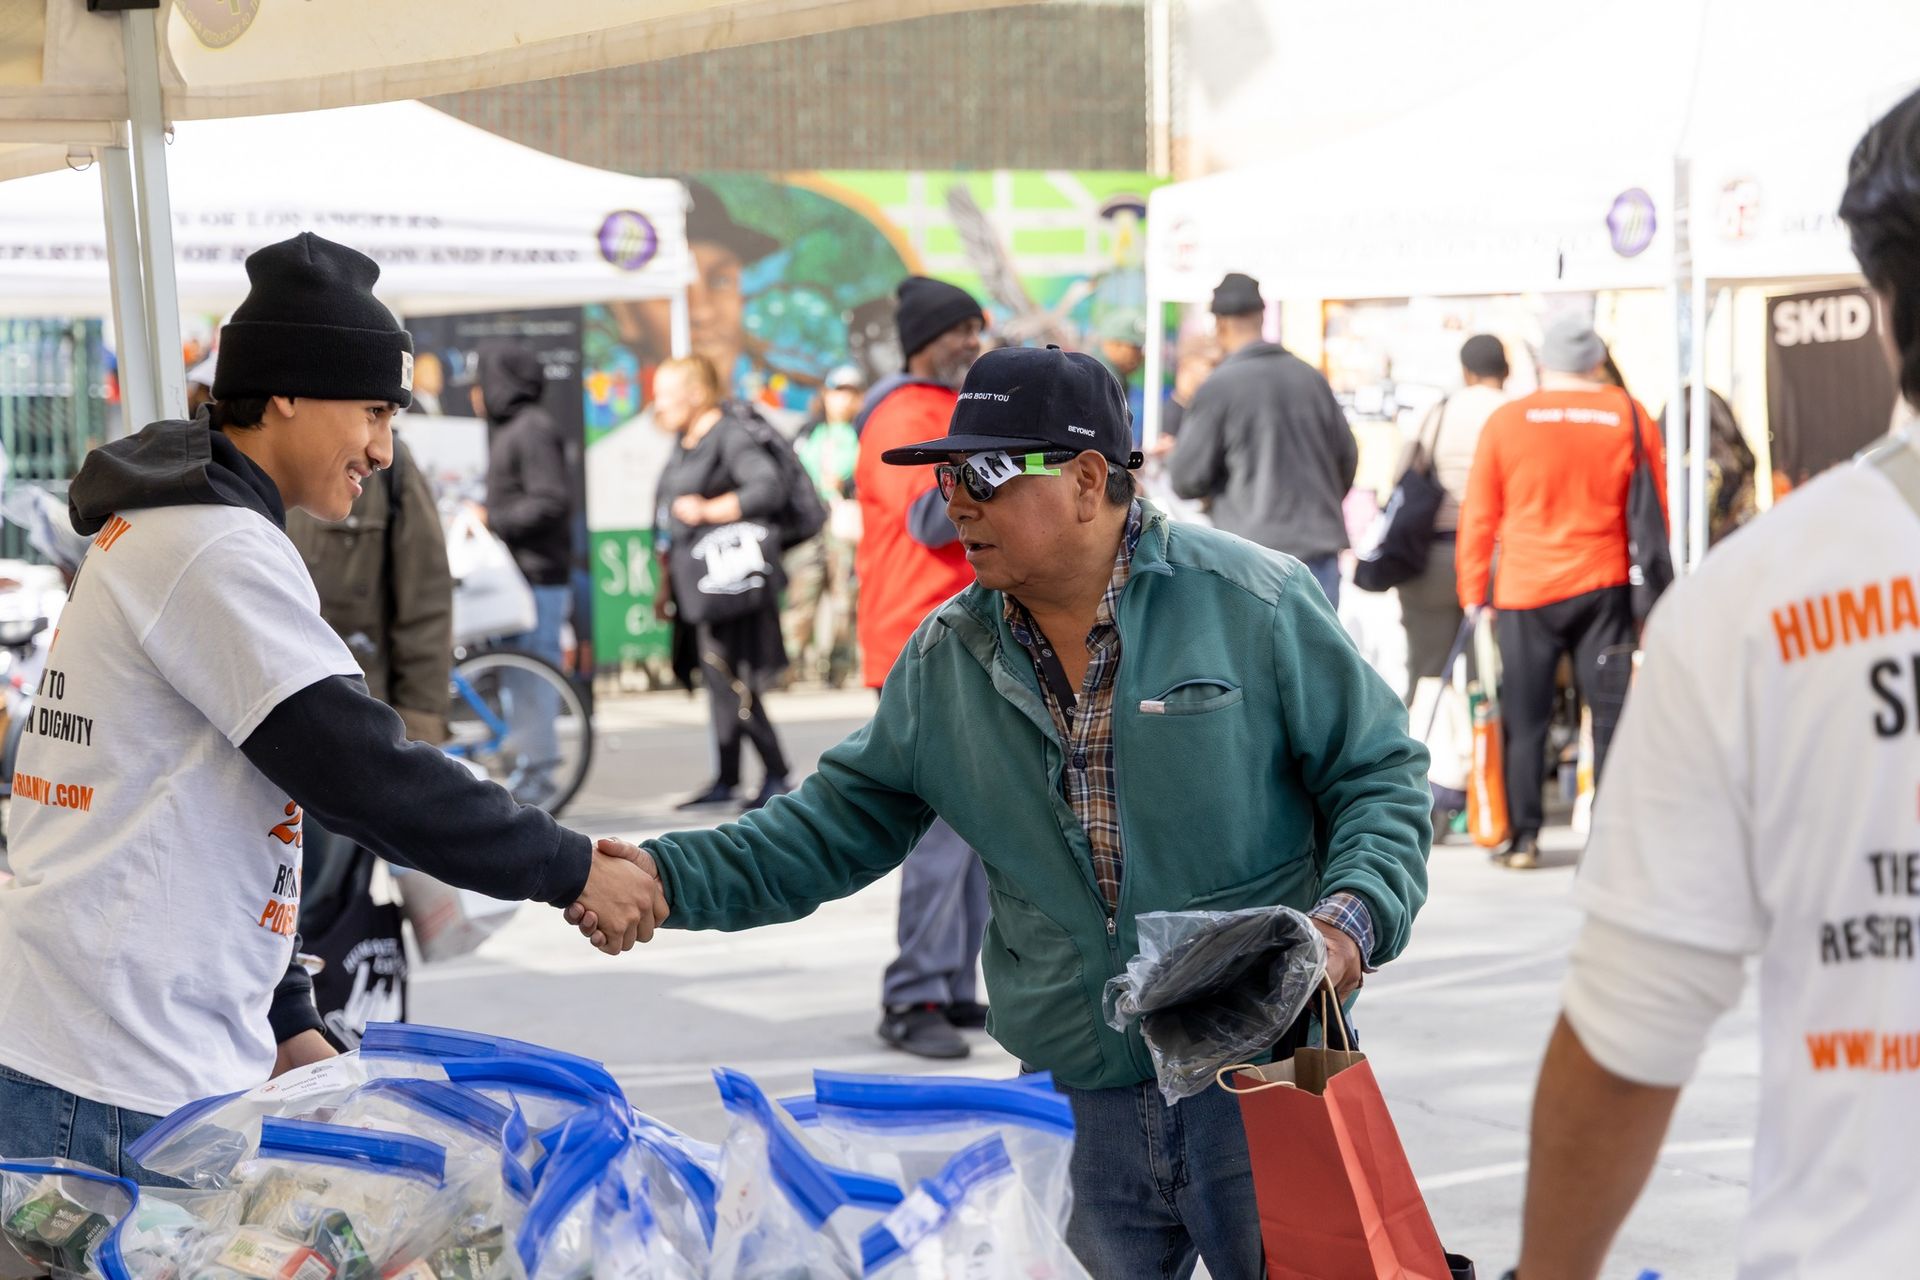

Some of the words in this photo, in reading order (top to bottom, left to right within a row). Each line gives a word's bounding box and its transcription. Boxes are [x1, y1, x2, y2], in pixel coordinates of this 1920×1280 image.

[1773, 294, 1871, 347] SKID
[994, 393, 1010, 403] YOU
[49, 669, 66, 700] TO
[1869, 655, 1920, 740] S
[39, 707, 94, 746] DIGNITY
